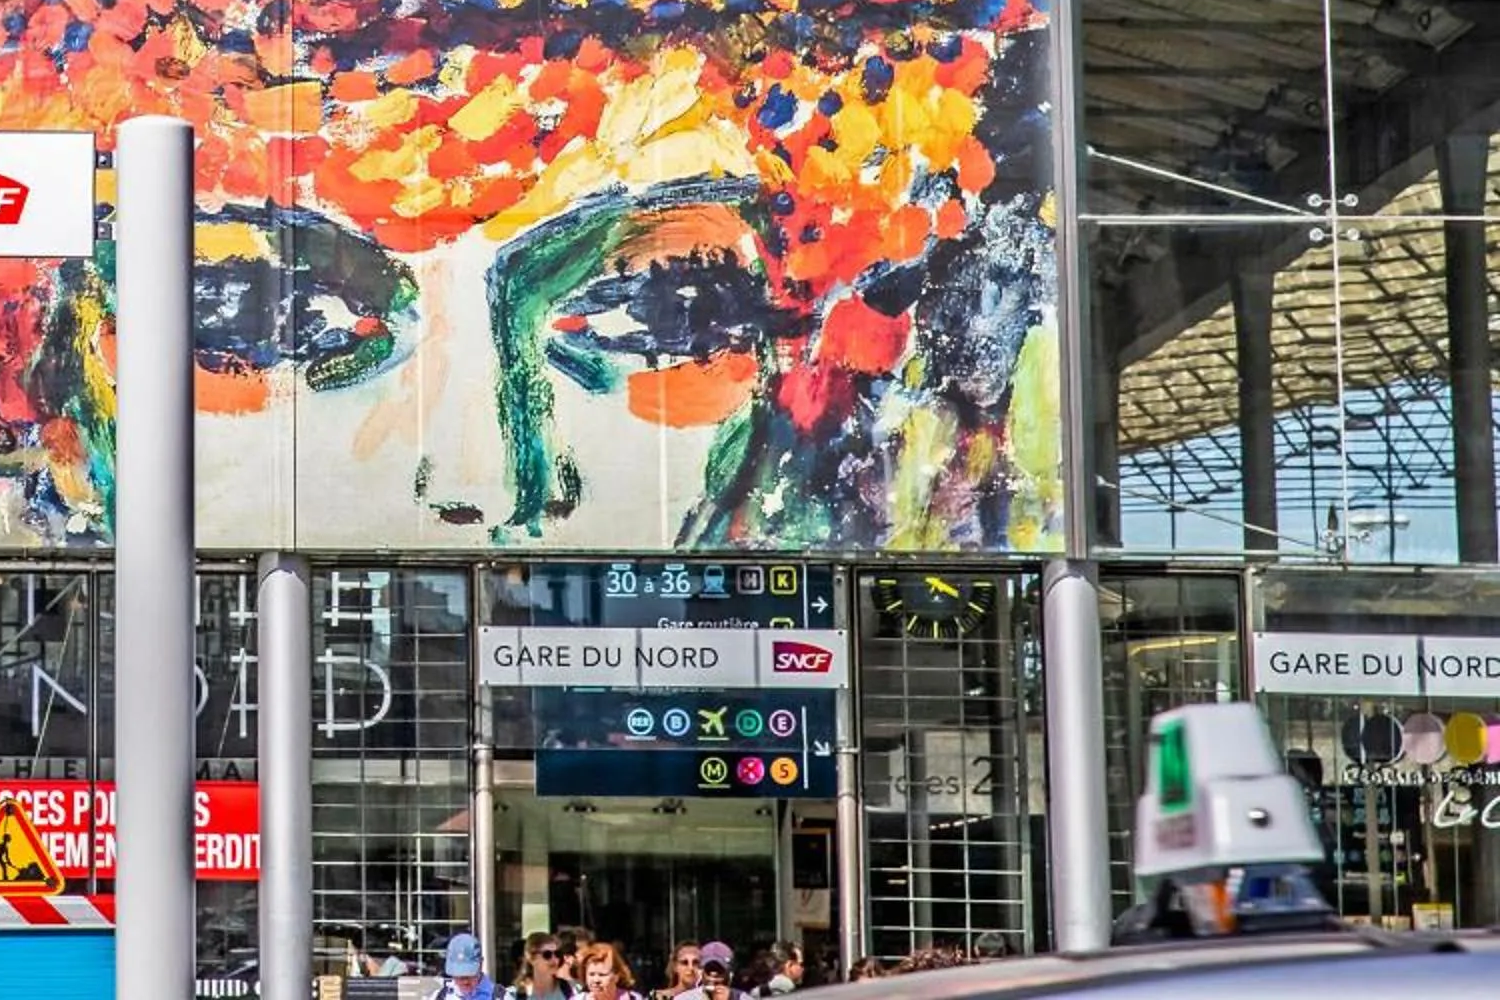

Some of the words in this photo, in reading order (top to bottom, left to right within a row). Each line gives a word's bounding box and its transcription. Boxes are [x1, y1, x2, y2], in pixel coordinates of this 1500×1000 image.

[606, 571, 637, 594] 30
[643, 578, 654, 594] à
[660, 571, 691, 594] 36
[493, 645, 571, 668] GARE
[582, 646, 622, 668] DU
[634, 646, 719, 669] NORD
[774, 652, 831, 671] SNCF
[1269, 651, 1349, 676] GARE
[1362, 653, 1403, 676] DU
